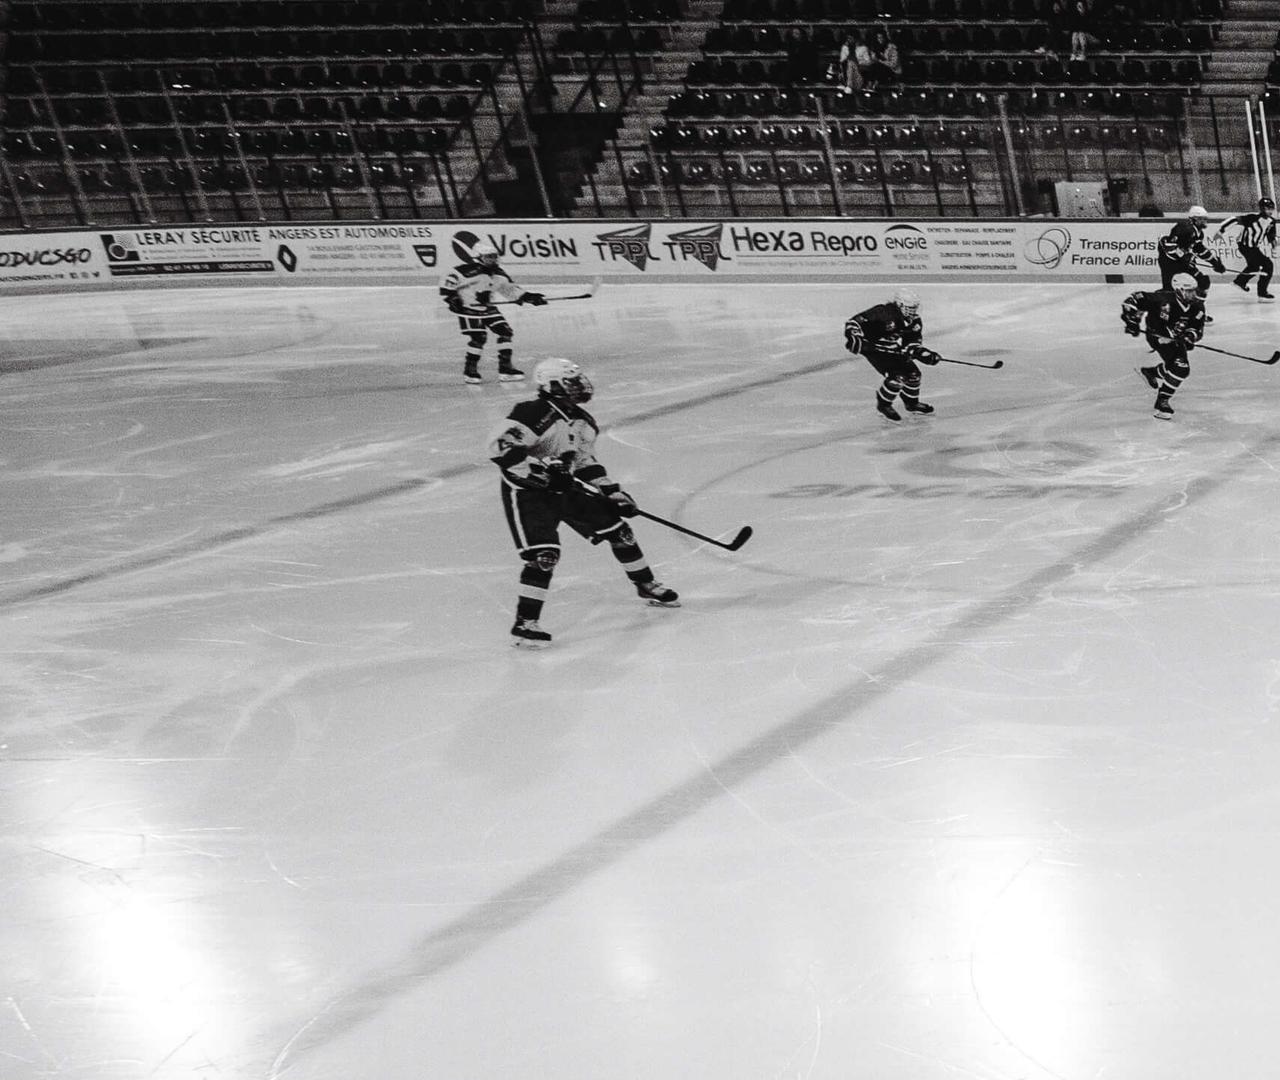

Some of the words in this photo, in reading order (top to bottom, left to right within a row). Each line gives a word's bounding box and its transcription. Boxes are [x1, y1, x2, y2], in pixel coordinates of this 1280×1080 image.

[136, 232, 185, 246] LERAY
[269, 229, 318, 239] ANGERS
[320, 228, 342, 239] EST
[345, 227, 433, 239] AUTOMOBILES
[731, 226, 804, 251] Hexa
[811, 231, 877, 256] Repro
[1079, 238, 1156, 252] Transports
[1071, 254, 1120, 266] France
